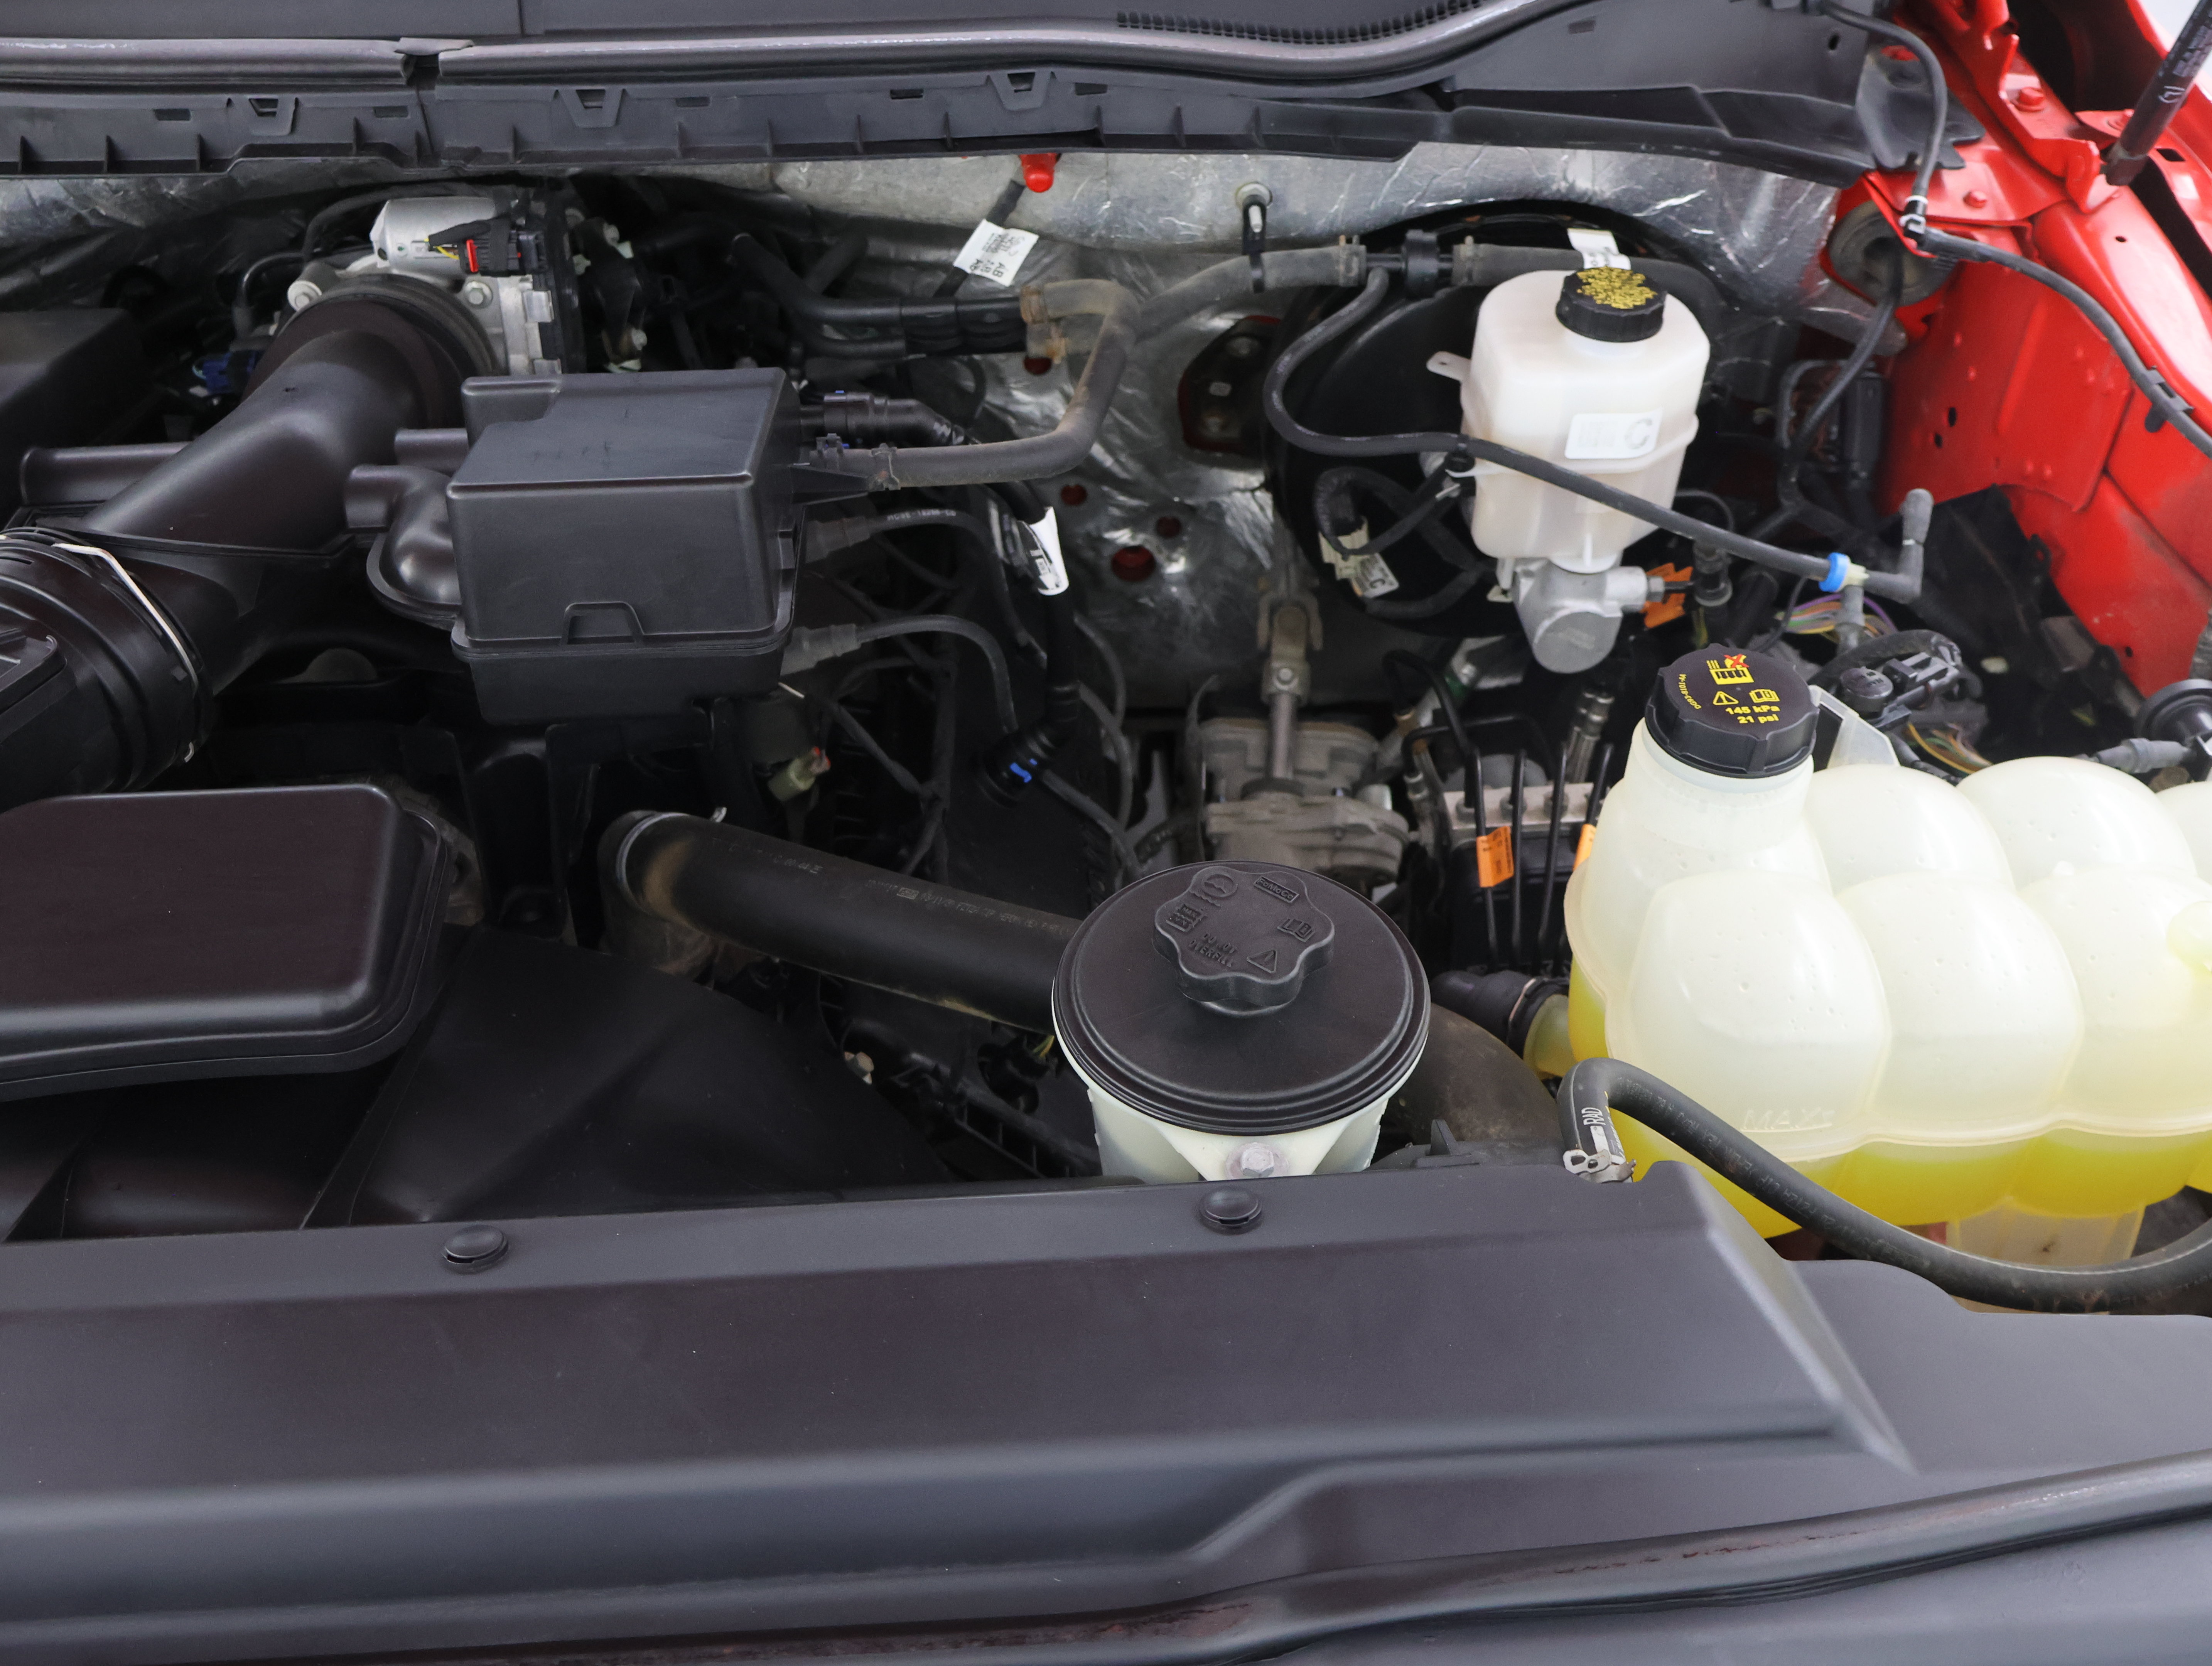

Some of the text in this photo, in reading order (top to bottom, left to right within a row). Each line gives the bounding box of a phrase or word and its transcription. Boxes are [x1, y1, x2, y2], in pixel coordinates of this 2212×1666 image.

[1725, 706, 1751, 715] 145
[1737, 714, 1779, 724] 21 psi
[1257, 879, 1294, 899] FoMoCo
[1581, 1107, 1606, 1125] RAD
[1742, 1106, 1821, 1130] MAX
